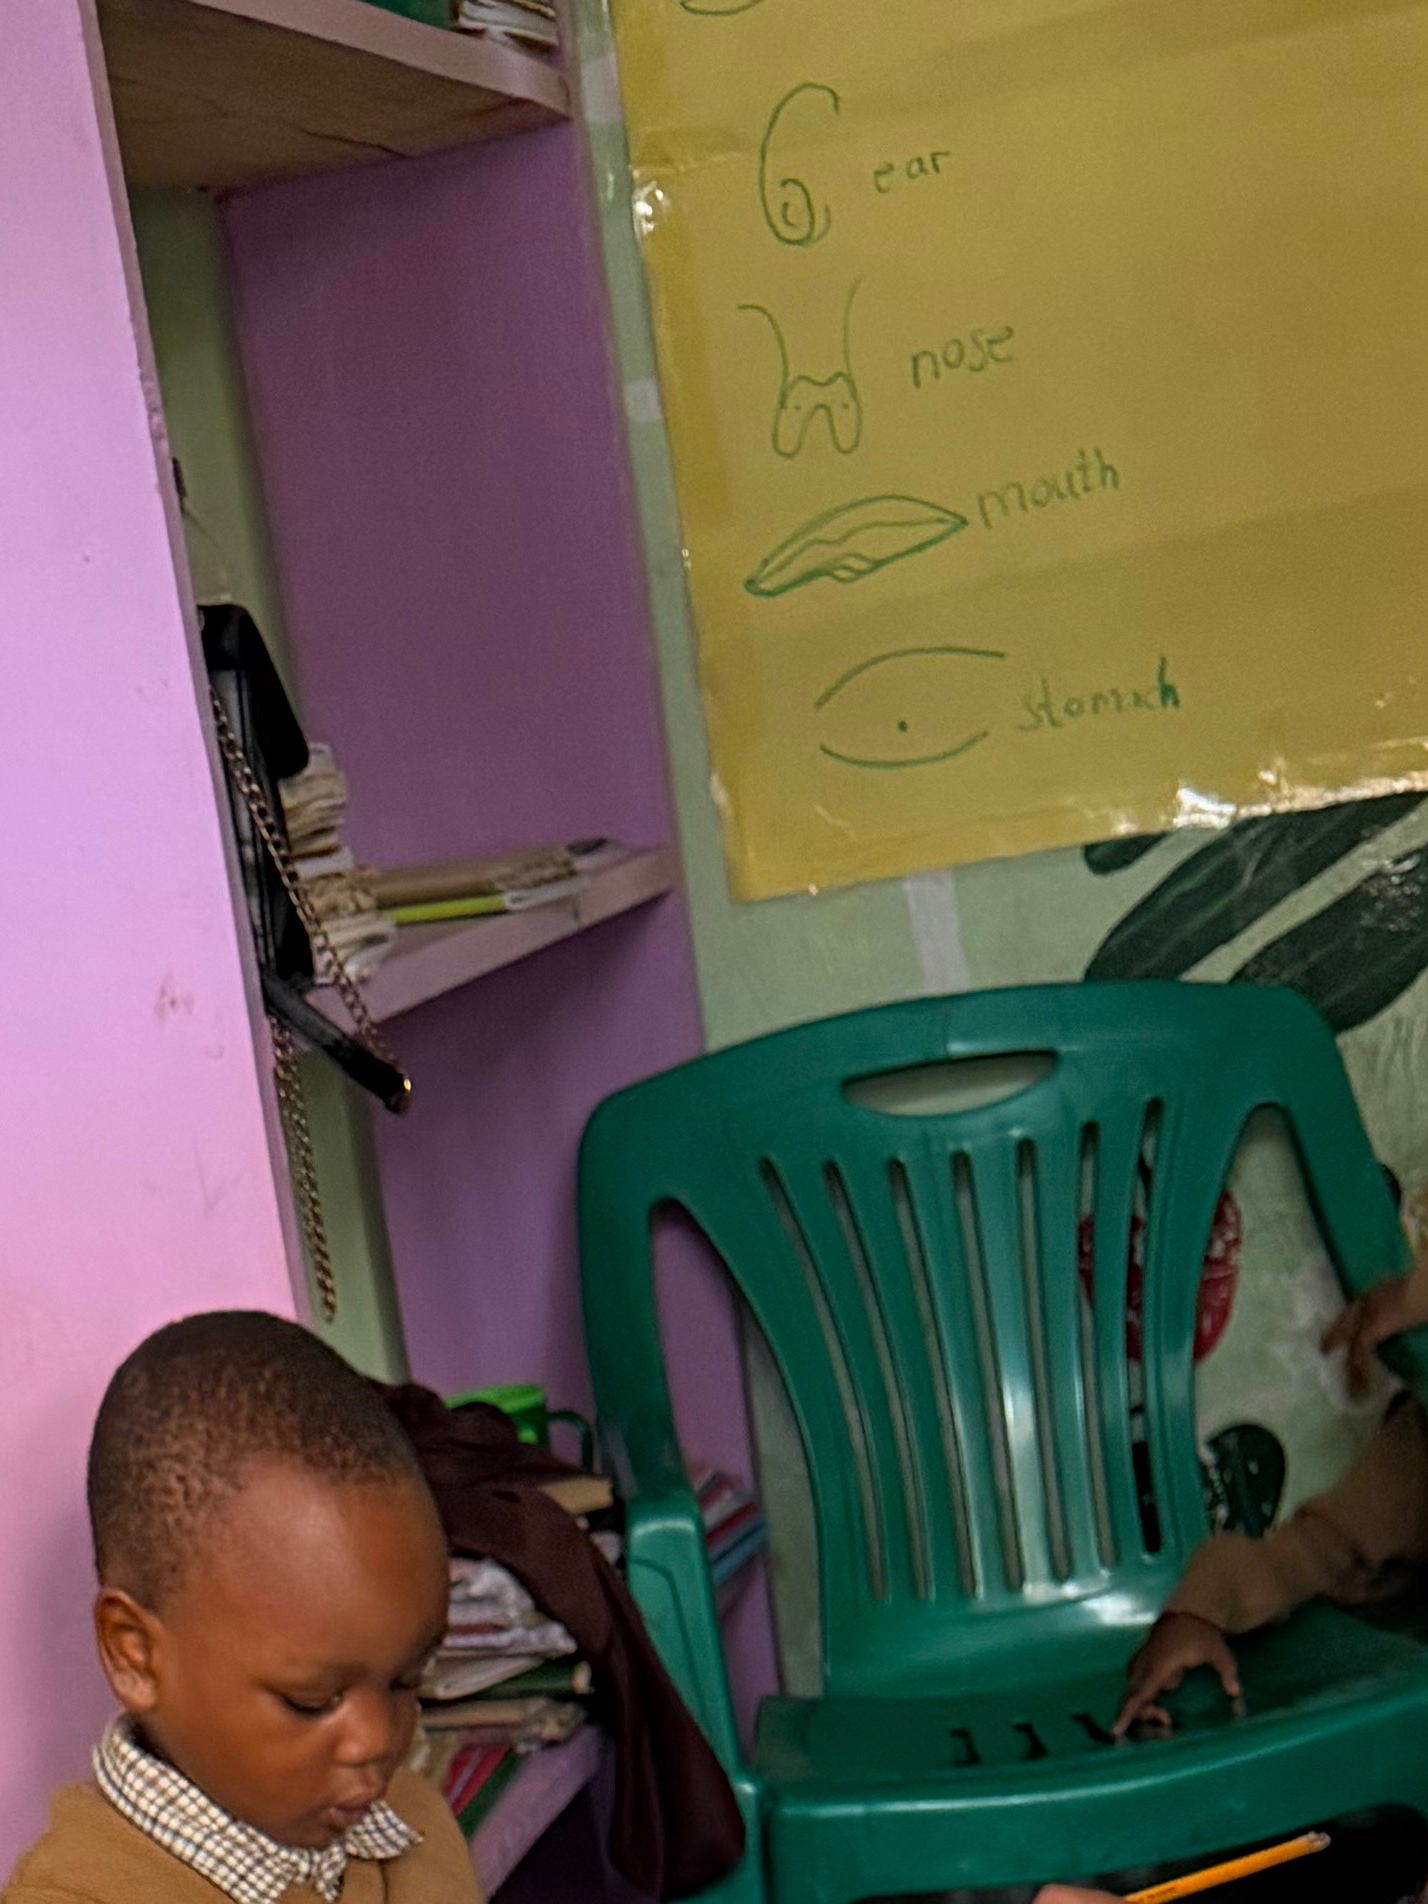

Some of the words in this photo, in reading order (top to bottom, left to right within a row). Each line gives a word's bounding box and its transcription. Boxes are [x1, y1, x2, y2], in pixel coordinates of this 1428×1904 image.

[872, 147, 951, 194] ear
[910, 320, 1016, 389] nose
[976, 447, 1120, 530] mouth
